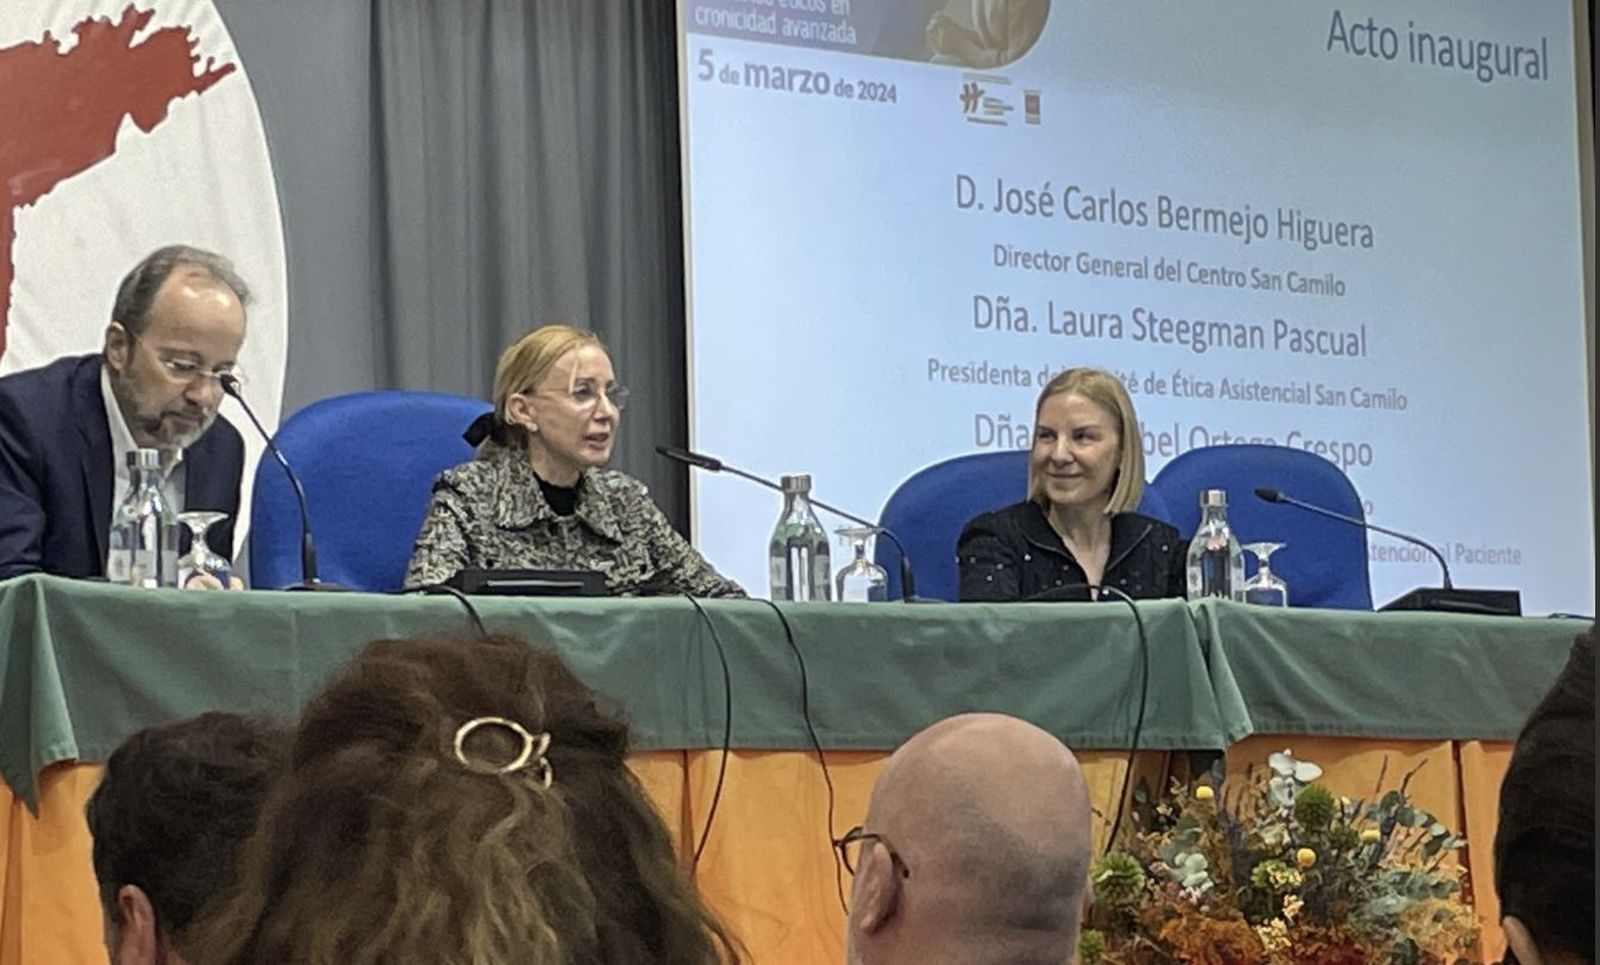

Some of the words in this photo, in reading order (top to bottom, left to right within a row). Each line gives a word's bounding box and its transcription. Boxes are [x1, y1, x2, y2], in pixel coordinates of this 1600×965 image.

[695, 6, 777, 35] cronicidad
[782, 17, 857, 44] avanzada
[1327, 9, 1398, 60] Acto
[1408, 20, 1549, 84] inaugural
[698, 48, 714, 81] 5
[719, 64, 741, 85] de
[744, 62, 831, 95] marzo
[834, 78, 854, 98] de
[857, 80, 897, 104] 2024
[955, 174, 984, 210] D.
[993, 178, 1054, 217] José
[1063, 186, 1148, 228] Carlos
[1158, 195, 1268, 245] Bermejo
[1277, 207, 1374, 251] Higuera
[993, 244, 1071, 274] Director
[1075, 251, 1149, 280] General
[1153, 258, 1182, 283] del
[1186, 261, 1247, 289] Centro
[1250, 267, 1283, 291] San
[1286, 271, 1346, 298] Camilo
[973, 295, 1037, 334] Dña.
[1048, 301, 1124, 340] Laura
[1131, 307, 1265, 354] Steegman
[1274, 319, 1367, 358] Pascual
[927, 358, 1032, 388] Presidenta
[1143, 371, 1167, 396] de
[1172, 370, 1214, 399] Ética
[1219, 377, 1312, 405] Asistencial
[1315, 384, 1347, 407] San
[1350, 387, 1408, 411] Camilo
[1141, 422, 1181, 457] bel
[1369, 542, 1434, 563] tención
[1455, 543, 1522, 566] Paciente
